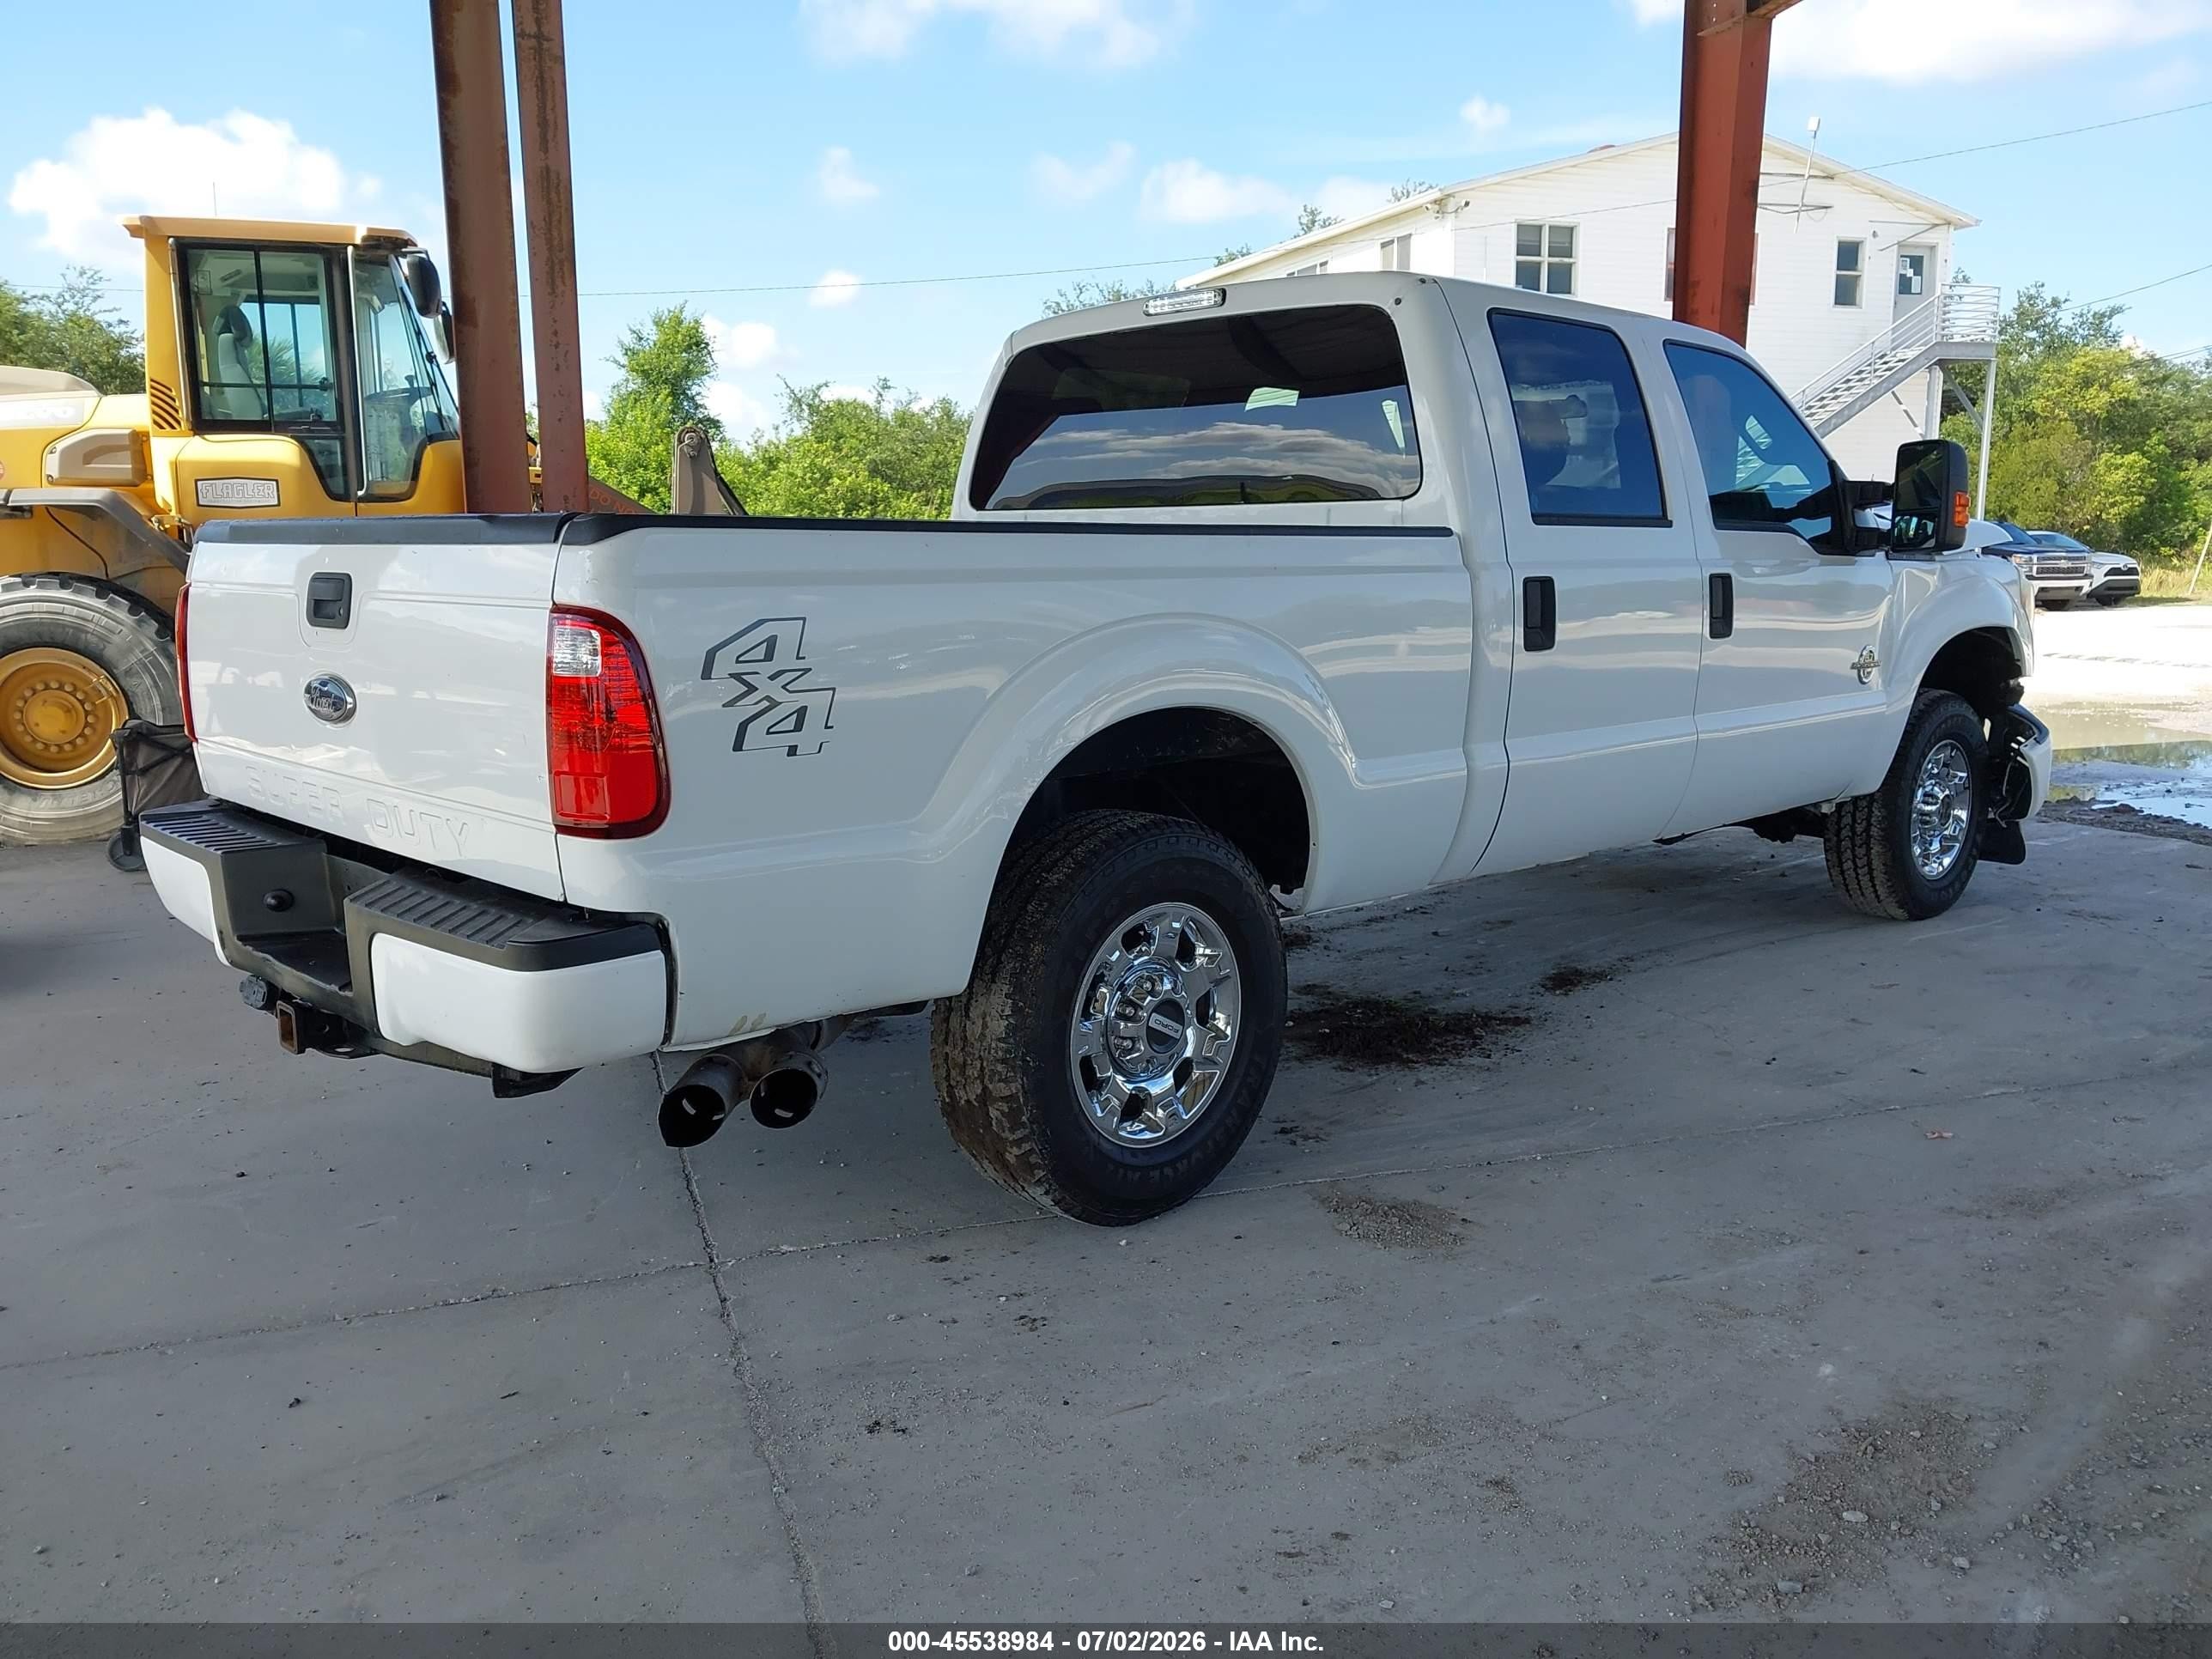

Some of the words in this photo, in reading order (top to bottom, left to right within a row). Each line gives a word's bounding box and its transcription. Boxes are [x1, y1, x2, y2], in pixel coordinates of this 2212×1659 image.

[200, 483, 275, 498] FLAGLER
[246, 765, 343, 824] SUPER
[365, 798, 468, 858] DUTY
[1154, 1018, 1179, 1034] FORD
